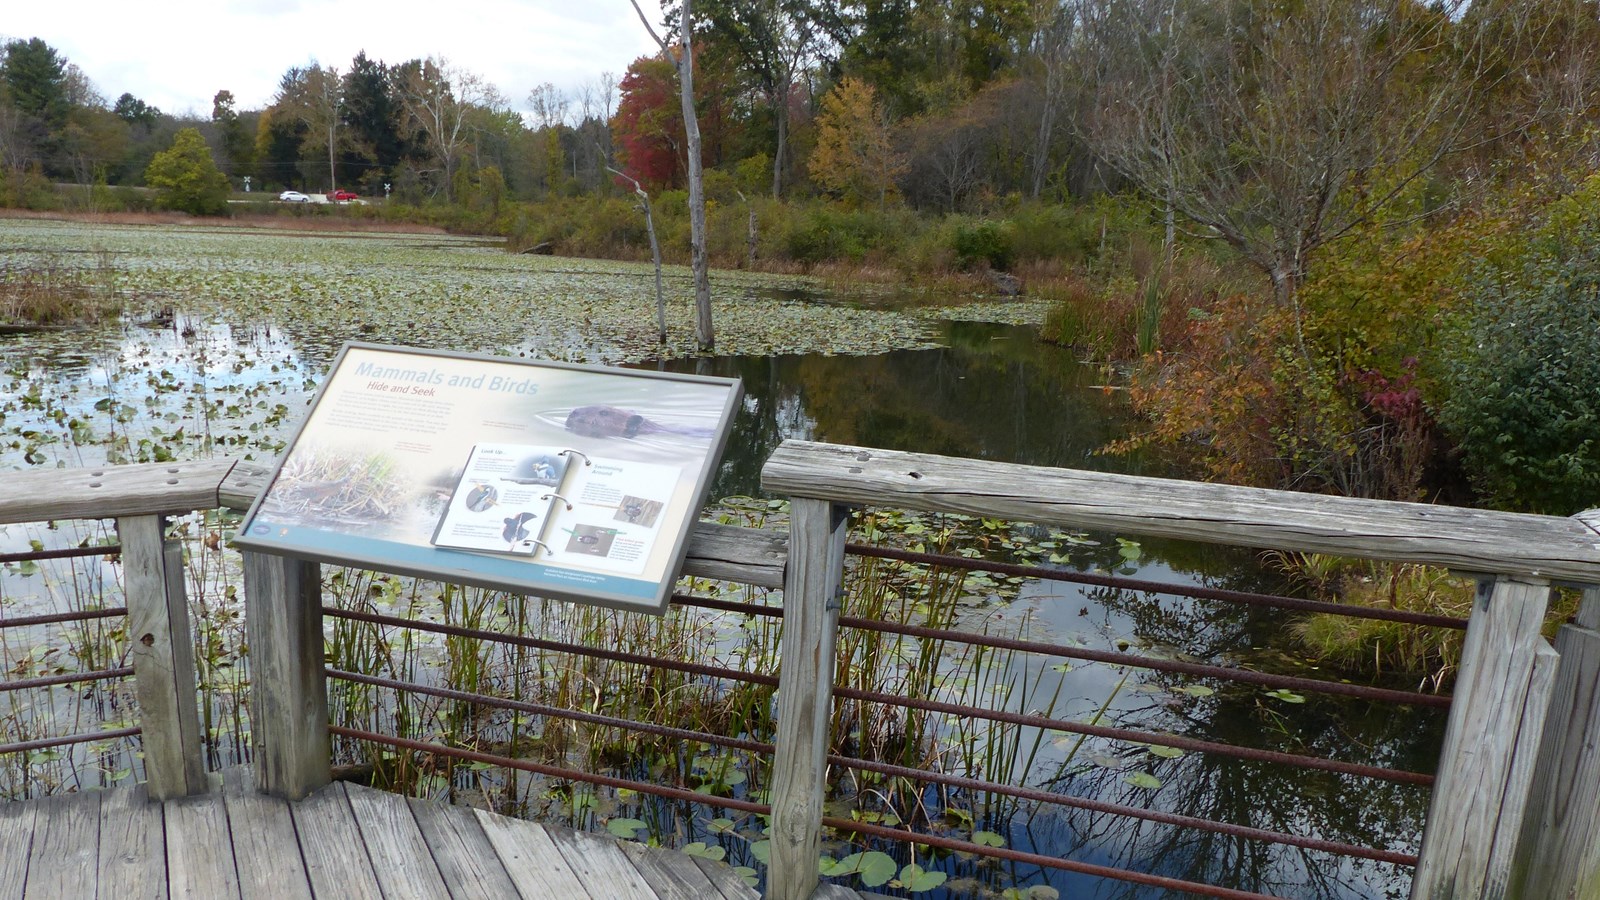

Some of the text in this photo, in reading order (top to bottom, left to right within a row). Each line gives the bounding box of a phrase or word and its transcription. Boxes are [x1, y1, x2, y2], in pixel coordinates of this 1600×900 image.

[354, 361, 540, 396] Mammals and Birds
[366, 380, 436, 397] Hide and Seek
